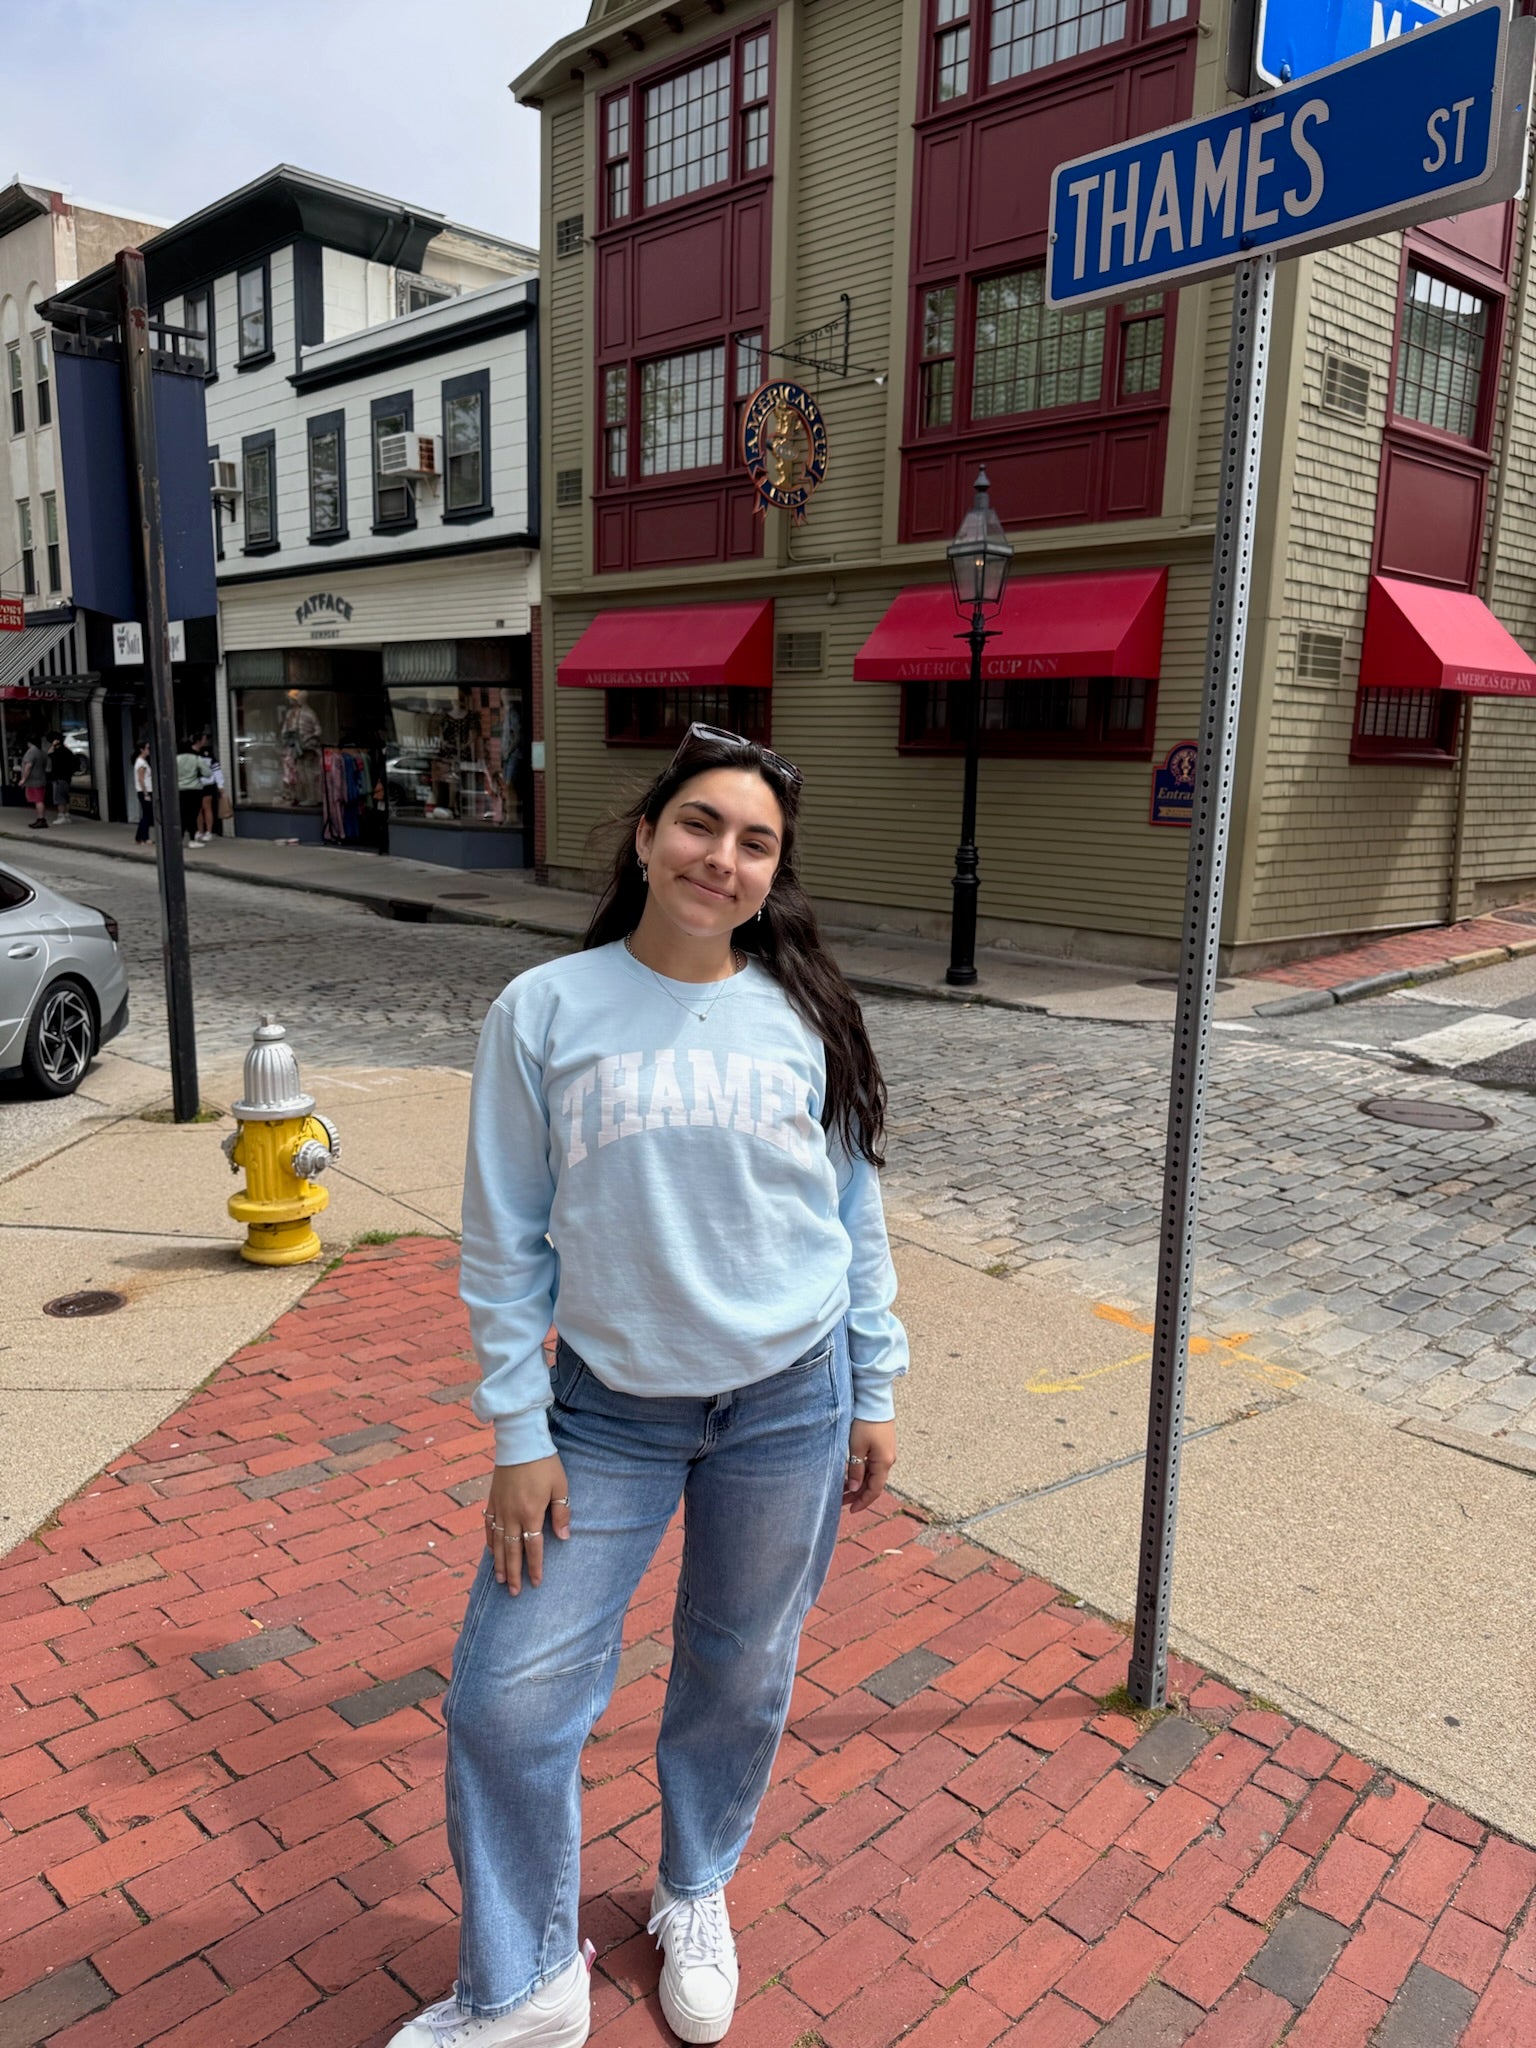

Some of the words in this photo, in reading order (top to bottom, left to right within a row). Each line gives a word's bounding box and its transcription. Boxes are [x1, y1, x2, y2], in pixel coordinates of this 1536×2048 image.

[1068, 98, 1330, 281] THAMES
[1422, 97, 1475, 173] ST
[747, 385, 818, 455] AMERICA'S
[812, 422, 827, 470] CUP
[769, 487, 802, 505] INN
[295, 592, 354, 626] FATFACE
[987, 659, 1022, 675] CUP
[1026, 658, 1059, 674] INN
[644, 671, 667, 684] CUP
[669, 670, 691, 683] INN
[1500, 676, 1516, 690] CUP
[1517, 678, 1532, 692] INN
